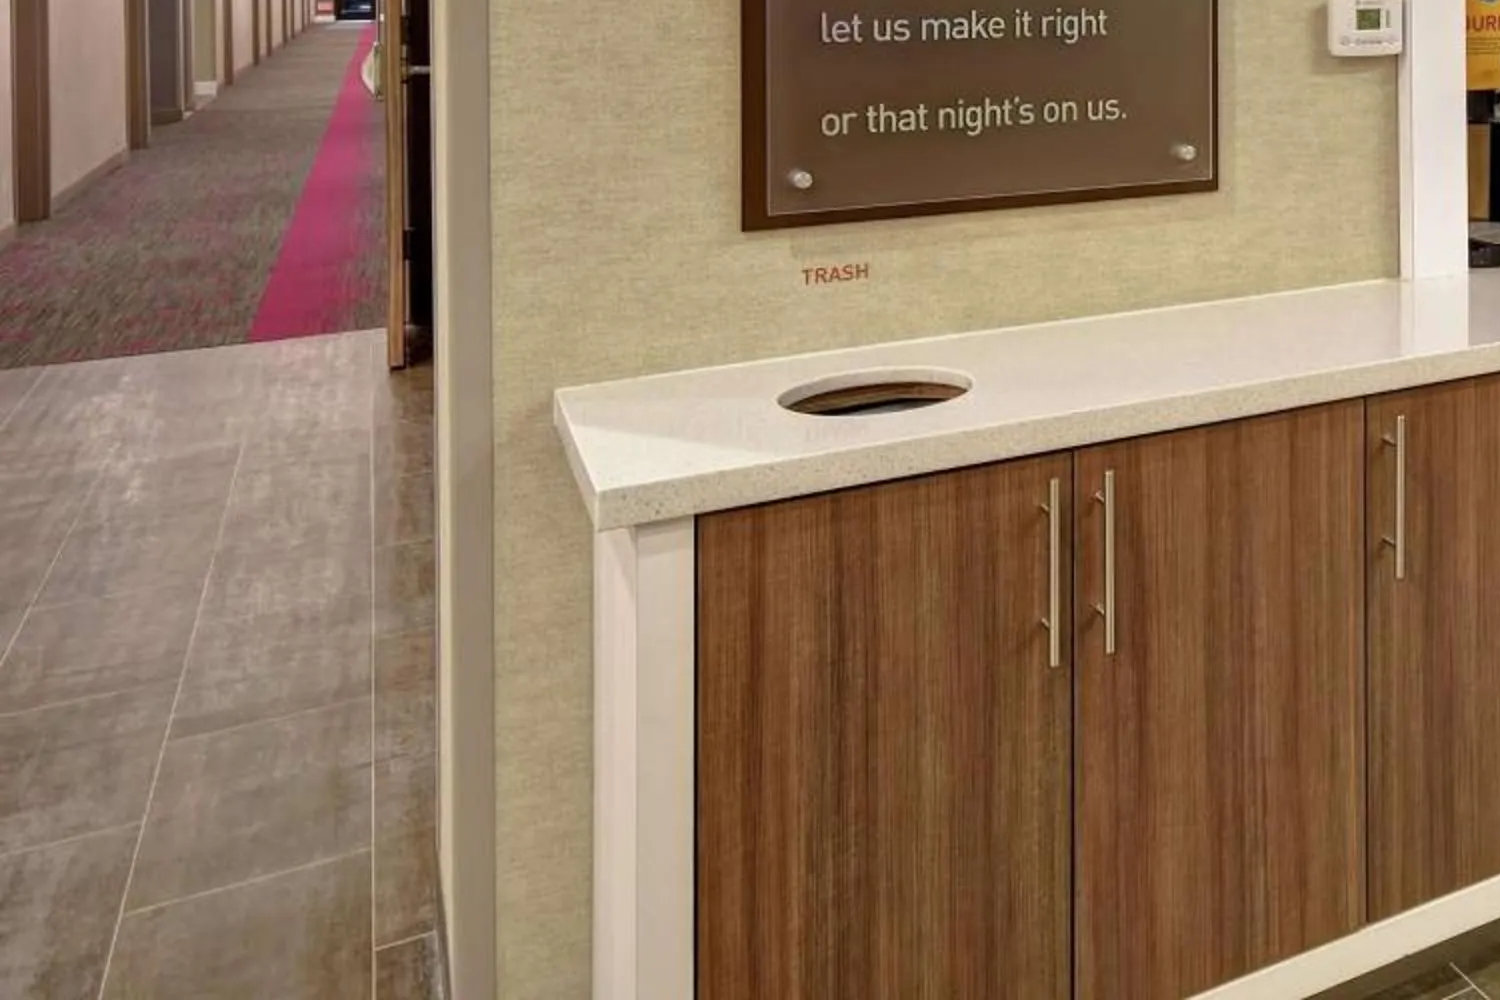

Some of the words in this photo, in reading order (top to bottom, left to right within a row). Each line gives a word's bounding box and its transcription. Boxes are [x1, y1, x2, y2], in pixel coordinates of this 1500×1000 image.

[821, 12, 863, 43] let
[873, 19, 911, 42] us
[921, 9, 1005, 41] make
[1015, 7, 1033, 38] it
[1041, 7, 1108, 44] right
[821, 112, 858, 137] or
[866, 103, 929, 133] that
[938, 96, 1035, 137] night's
[1043, 101, 1078, 123] on
[1087, 99, 1127, 121] us.
[801, 263, 869, 286] TRASH
